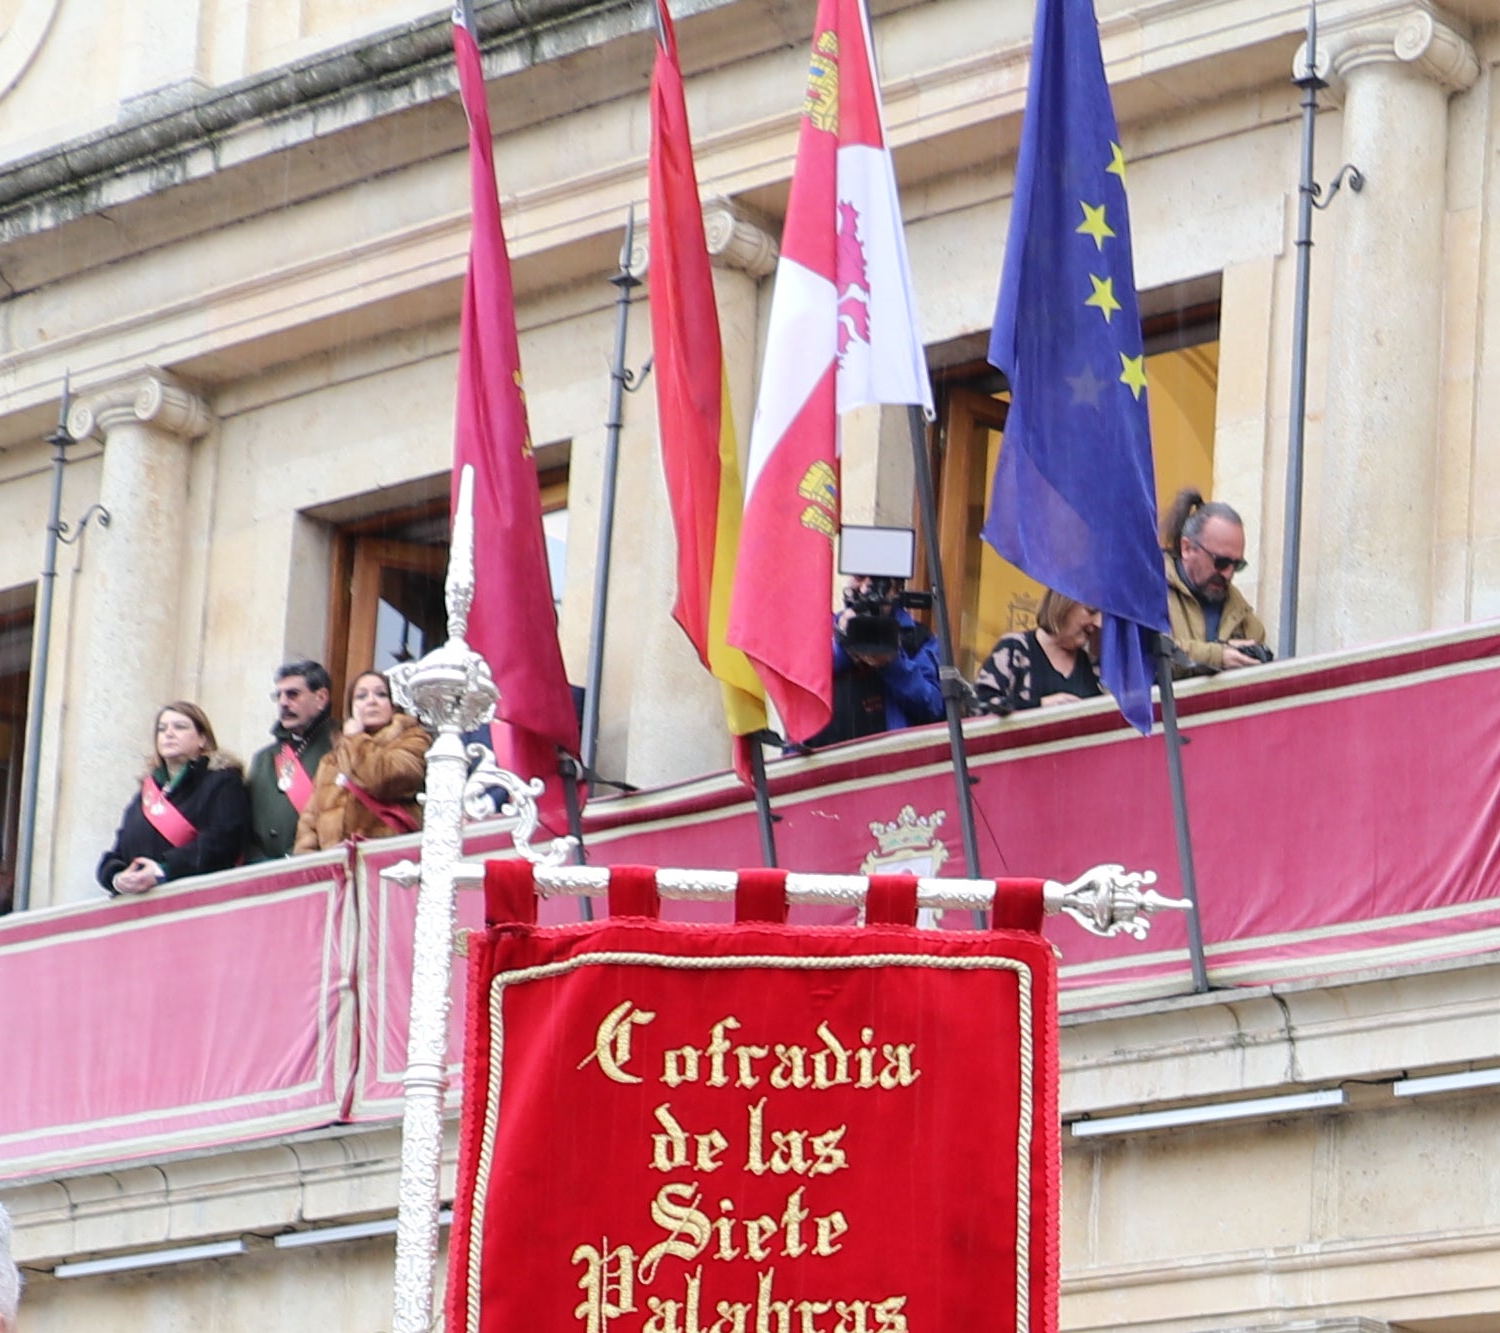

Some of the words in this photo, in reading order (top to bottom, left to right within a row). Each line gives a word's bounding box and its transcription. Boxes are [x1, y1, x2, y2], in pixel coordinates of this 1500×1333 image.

[648, 1103, 728, 1173] de
[743, 1096, 850, 1178] las
[637, 1181, 849, 1286] Siete
